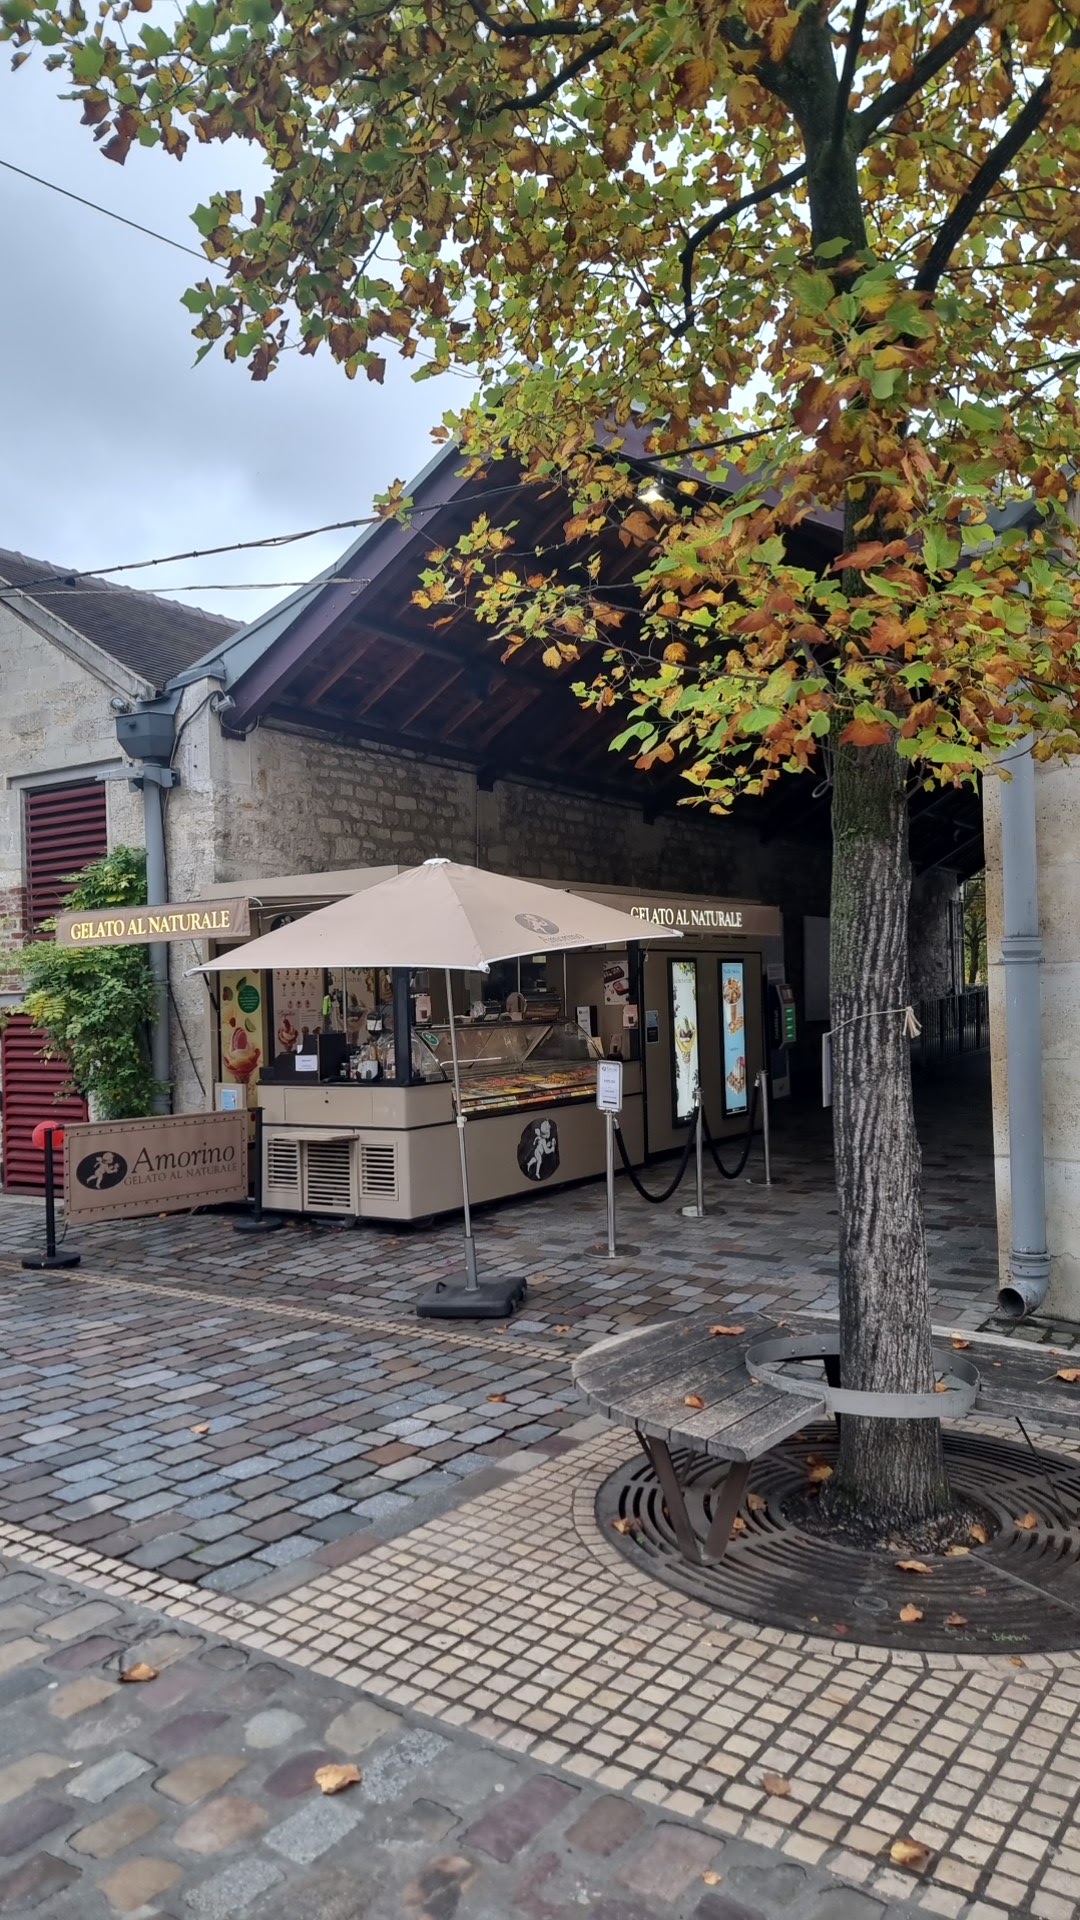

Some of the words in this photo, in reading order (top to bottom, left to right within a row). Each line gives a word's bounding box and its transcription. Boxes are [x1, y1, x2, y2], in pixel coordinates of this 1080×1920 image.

[71, 919, 125, 940] GELATO
[127, 917, 147, 936] AL
[148, 910, 230, 934] NATURALE
[631, 906, 674, 925] GELATO
[675, 909, 690, 926] AL
[690, 909, 743, 928] NATURALE
[131, 1142, 235, 1174] Amorino
[123, 1172, 167, 1186] GELATO
[169, 1170, 183, 1181] AL
[186, 1162, 238, 1178] NATURALE
